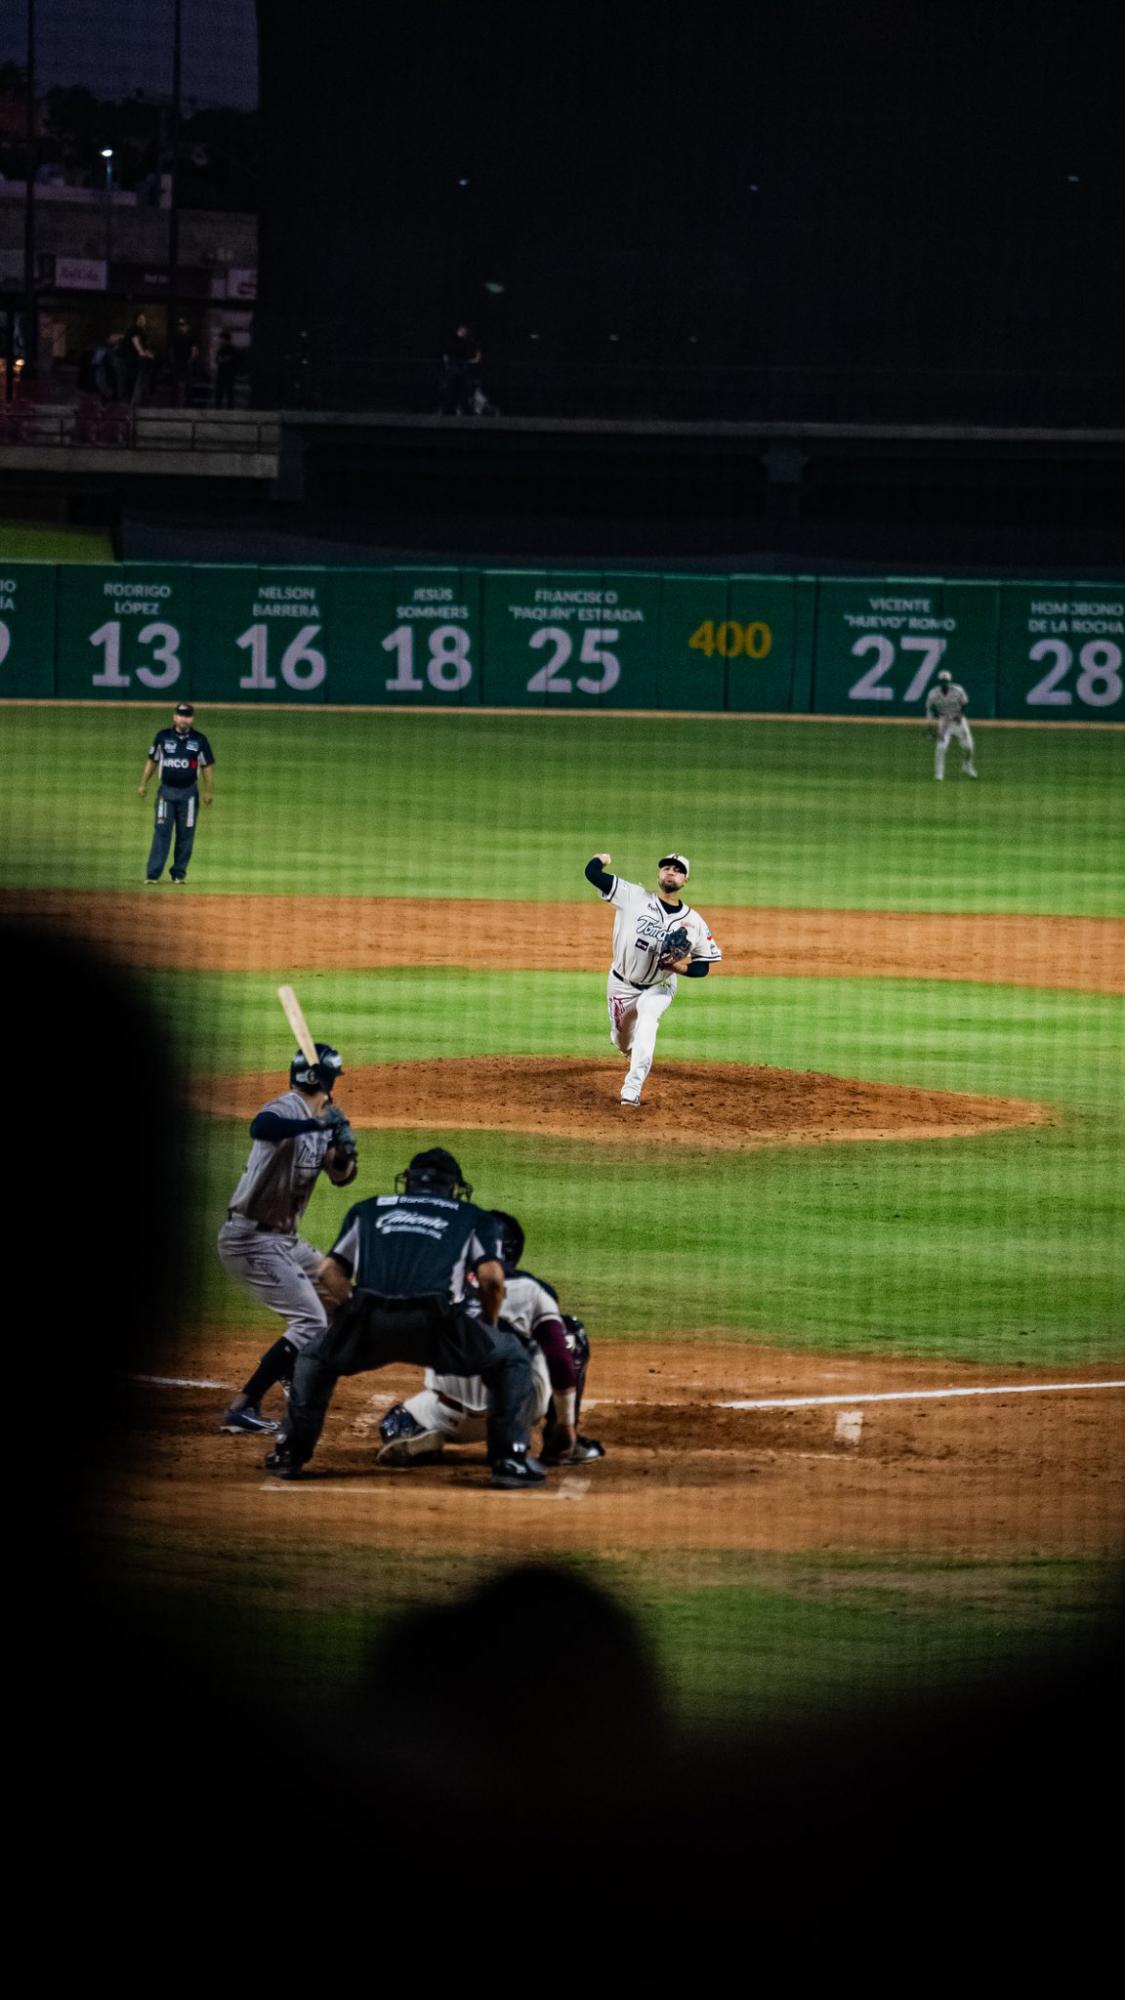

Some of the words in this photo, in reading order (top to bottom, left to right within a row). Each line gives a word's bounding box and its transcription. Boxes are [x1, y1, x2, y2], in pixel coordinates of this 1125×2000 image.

[104, 583, 171, 598] RODRIGO
[259, 587, 315, 600] NELSON
[535, 590, 618, 605] FRANCISCO
[114, 601, 160, 615] LÓPEZ
[253, 603, 319, 617] BARRERA
[396, 606, 469, 619] SOMMERS
[870, 598, 930, 612] VICENTE
[1031, 601, 1123, 616] HOMOBONO
[578, 608, 643, 622] ESTRADA
[1028, 619, 1047, 632] DE
[1050, 620, 1068, 633] LA
[1072, 620, 1124, 635] ROCHA
[689, 620, 771, 659] 400
[89, 621, 181, 688] 13
[236, 623, 326, 691] 16
[382, 625, 472, 691] 18
[527, 627, 620, 694] 25
[848, 634, 947, 702] 27
[1026, 638, 1123, 707] 28
